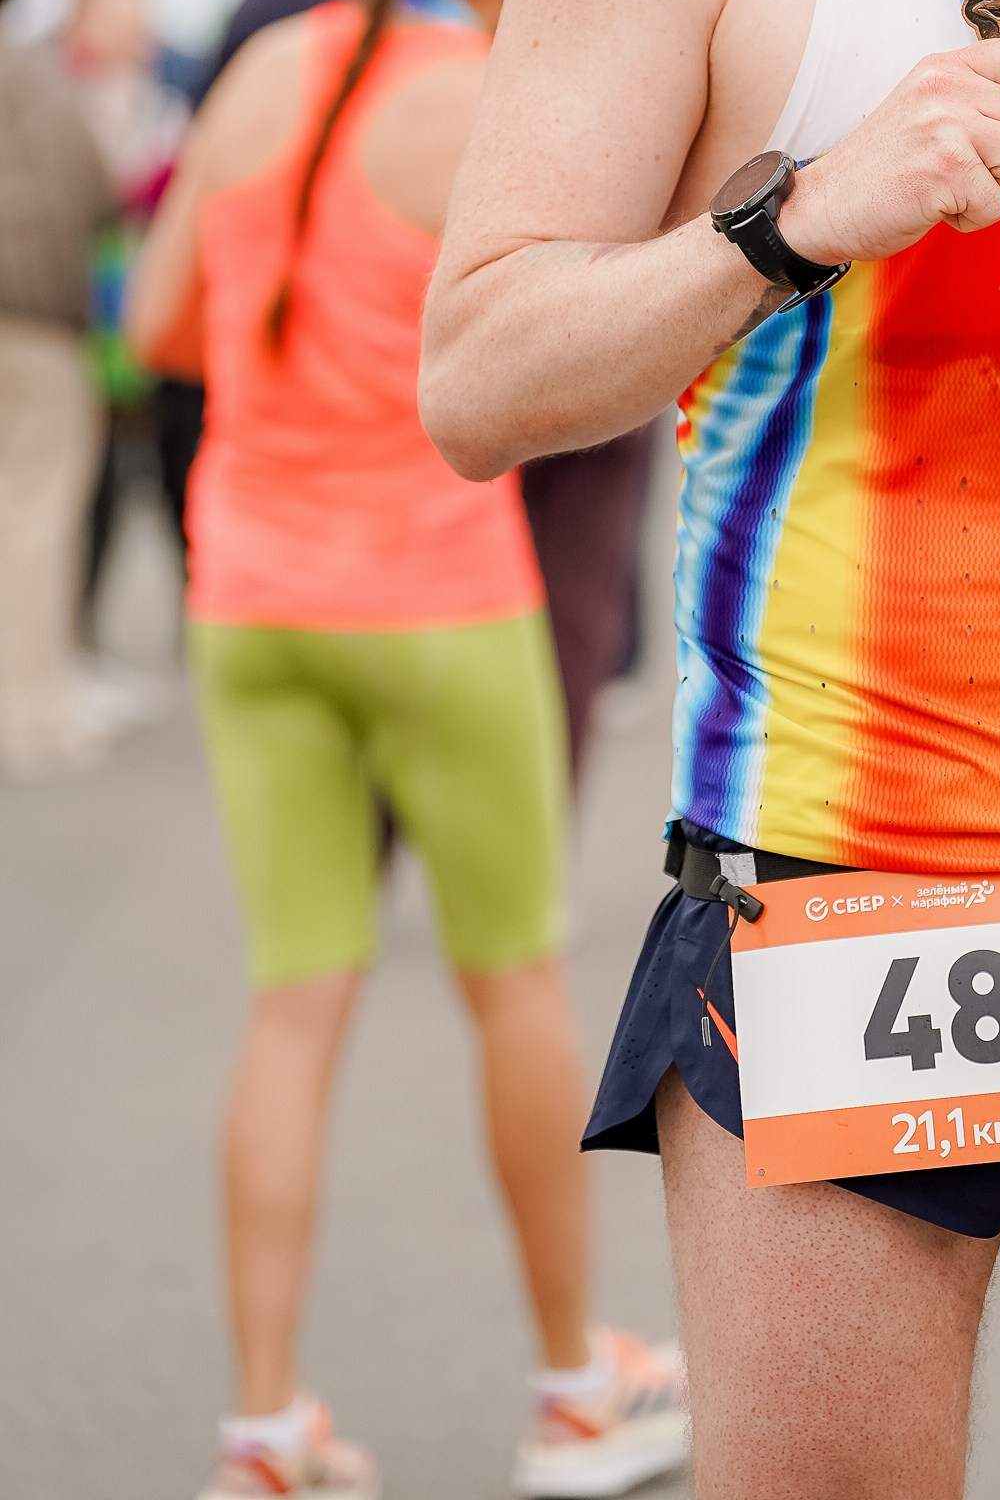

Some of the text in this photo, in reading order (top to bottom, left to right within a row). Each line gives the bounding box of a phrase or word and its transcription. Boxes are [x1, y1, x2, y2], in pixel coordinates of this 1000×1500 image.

[916, 882, 968, 897] зелёный
[832, 895, 885, 915] СБЕР
[910, 895, 965, 910] марафон
[891, 1106, 966, 1159] 21,1
